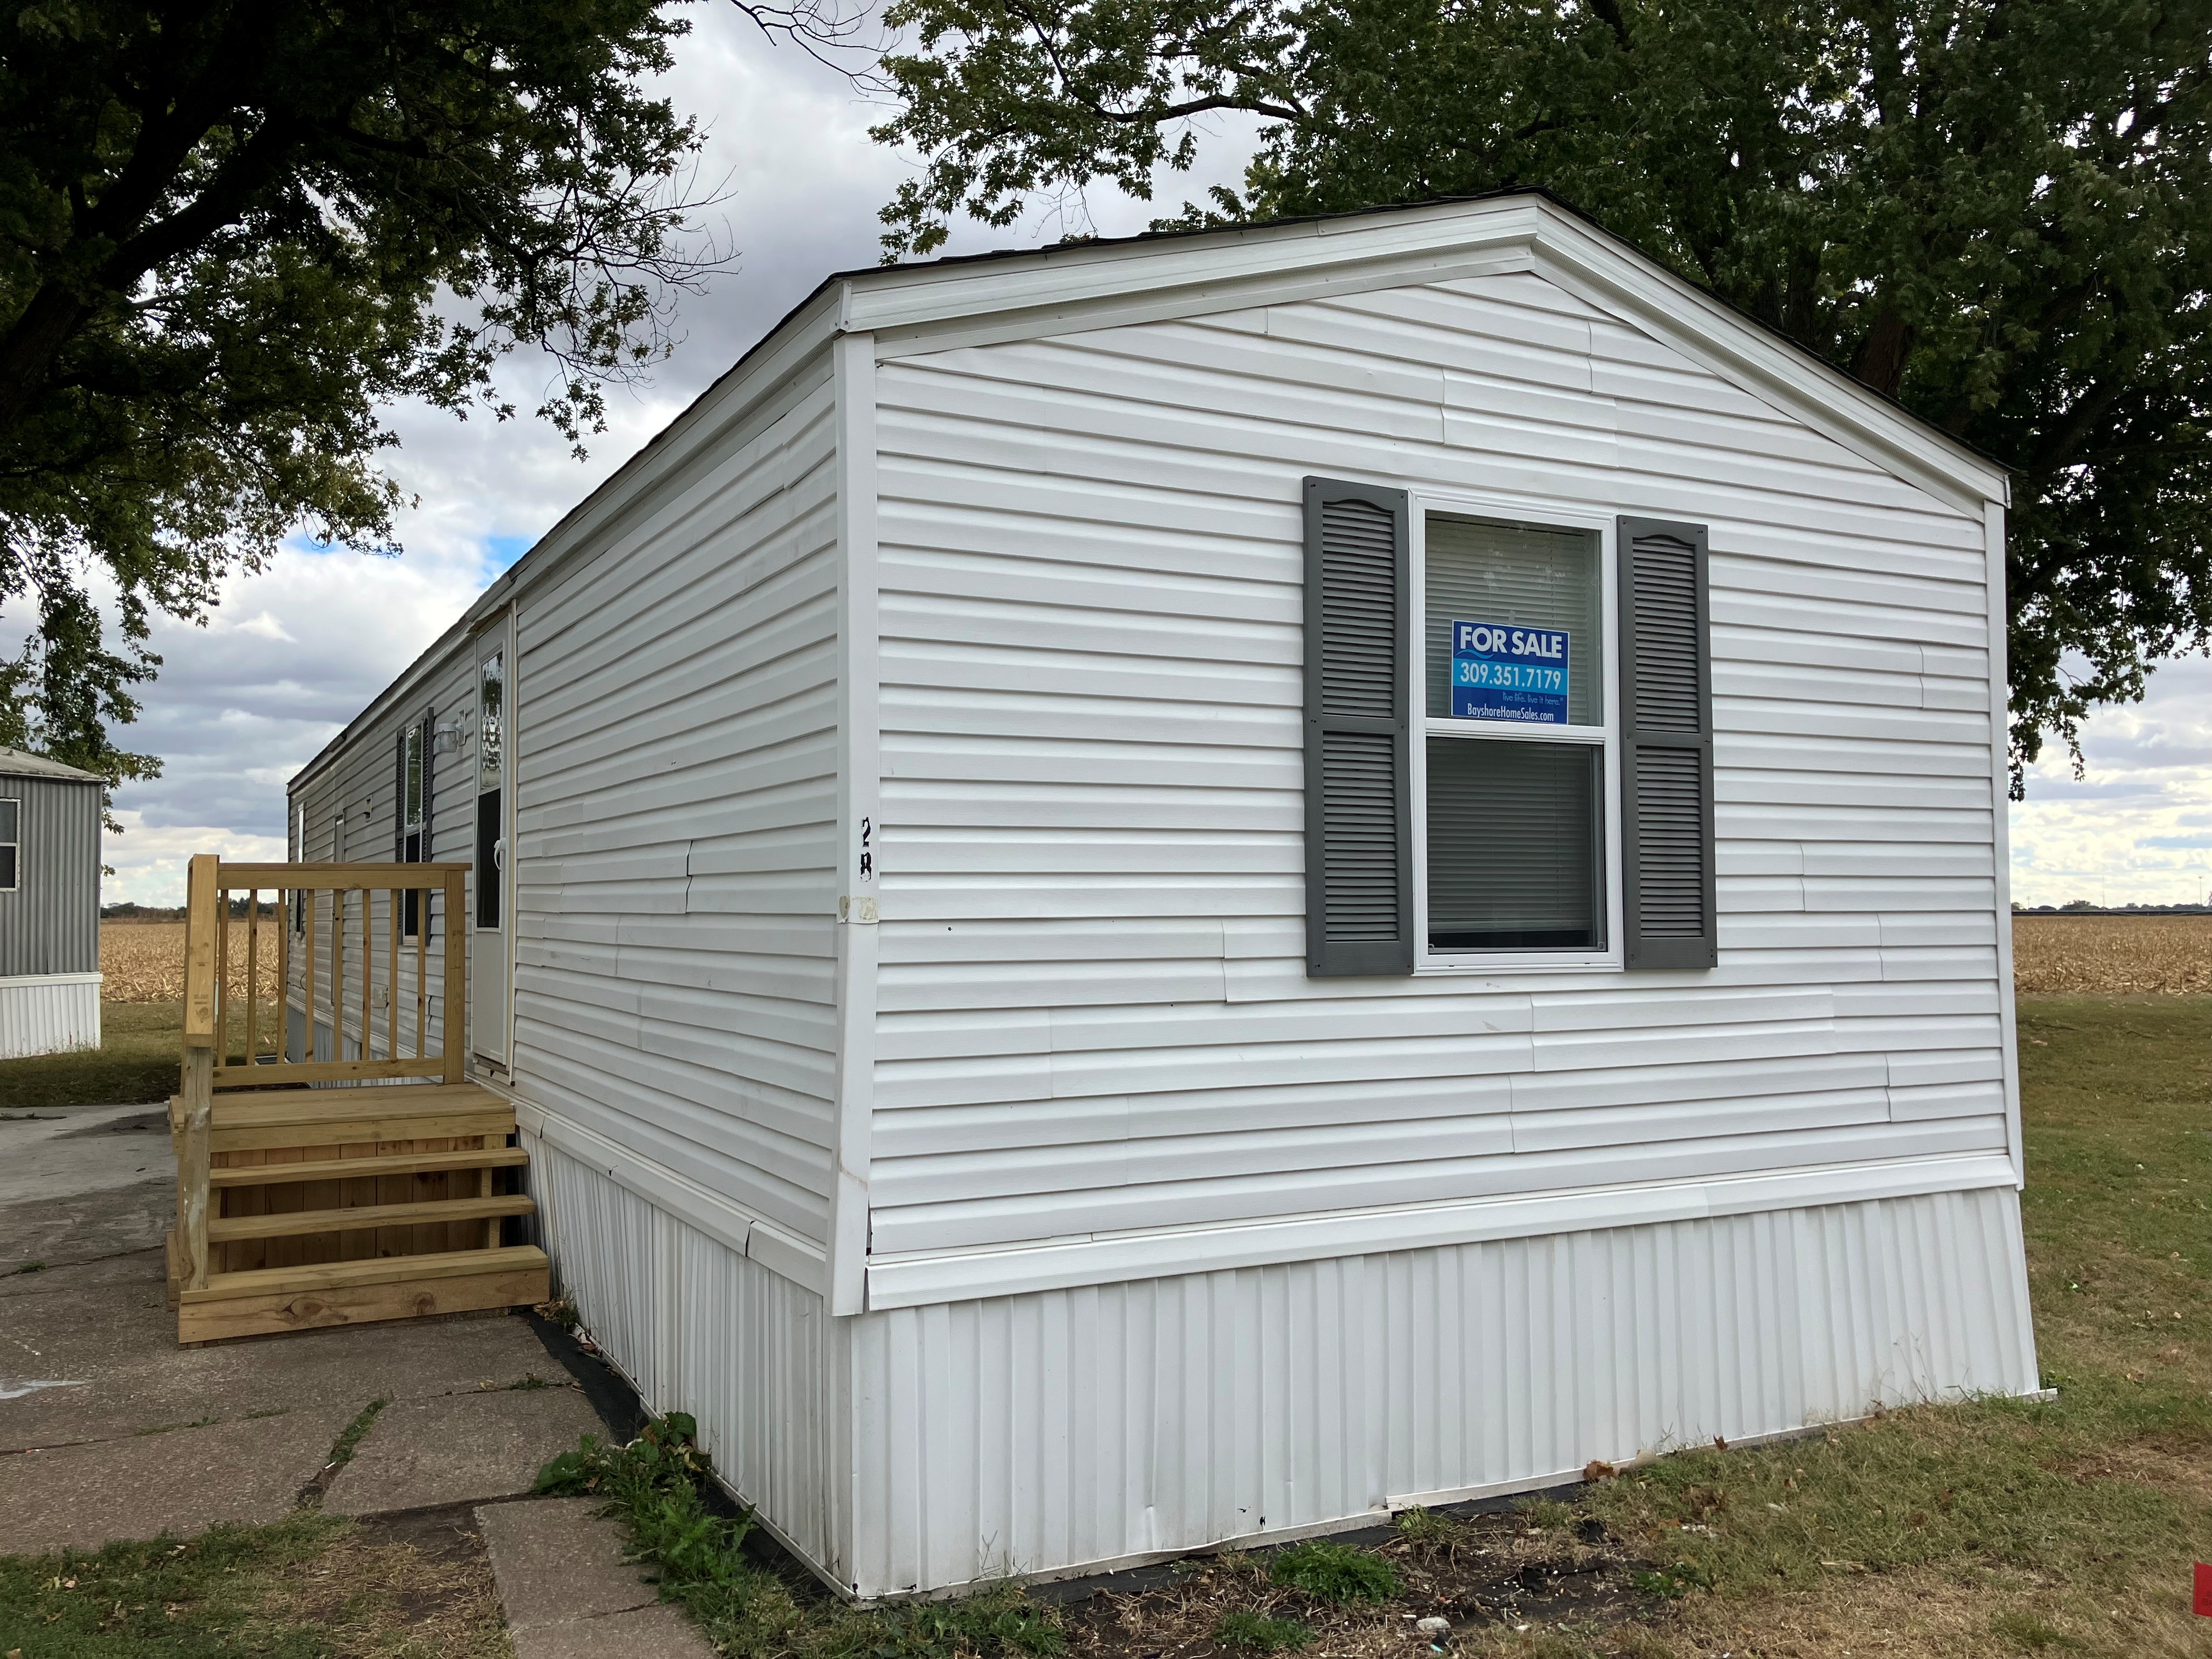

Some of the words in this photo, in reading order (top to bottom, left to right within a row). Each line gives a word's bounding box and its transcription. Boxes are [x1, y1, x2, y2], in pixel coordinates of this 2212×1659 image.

[1460, 625, 1508, 653] FOR
[1511, 630, 1562, 658] SALE
[1460, 662, 1561, 690] 309.351.7179
[1503, 691, 1514, 702] live
[1527, 693, 1538, 704] live
[1539, 695, 1544, 704] it
[1467, 703, 1554, 722] BayshoreHomeSales.com
